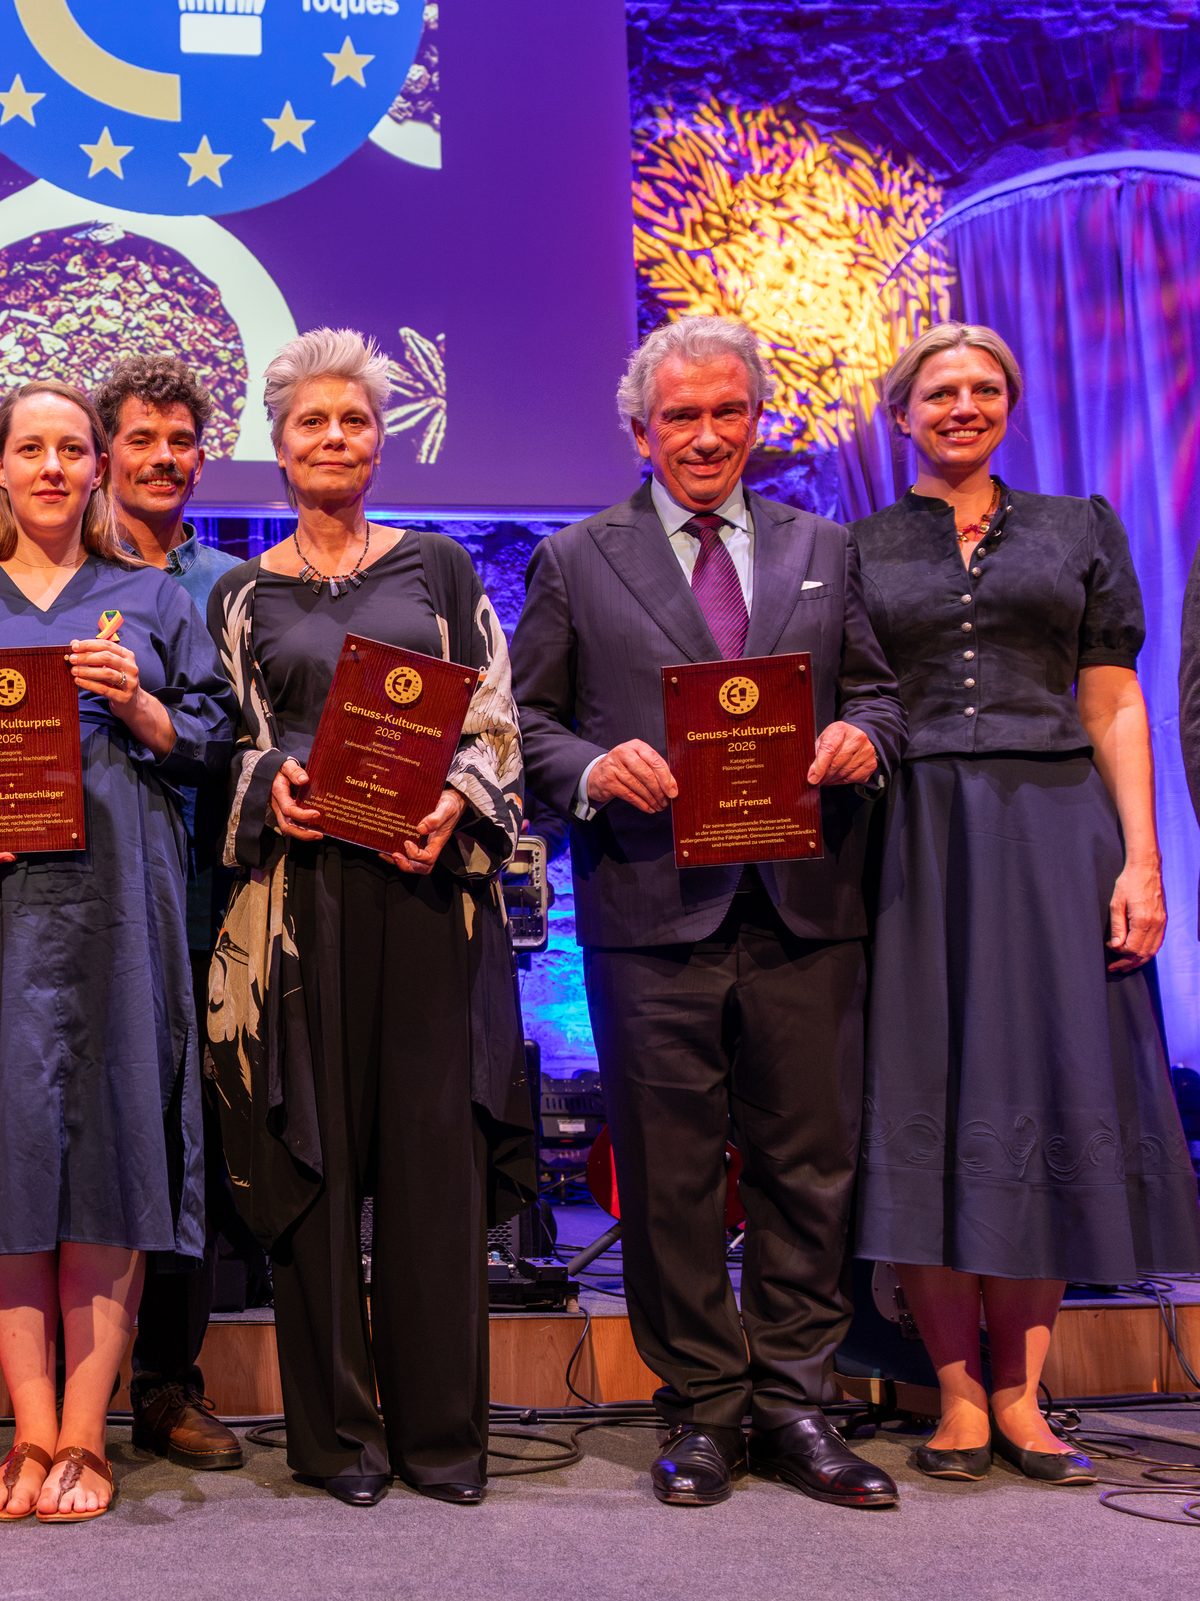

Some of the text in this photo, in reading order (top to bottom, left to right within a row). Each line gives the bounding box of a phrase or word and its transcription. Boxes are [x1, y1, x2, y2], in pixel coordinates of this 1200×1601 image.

[342, 701, 443, 739] Genuss-Kulturpreis
[374, 726, 402, 740] 2026
[687, 722, 796, 743] Genuss-Kulturpreis
[727, 740, 756, 752] 2026
[722, 764, 745, 772] Flüssiger
[345, 776, 399, 797] Sarah Wiener
[0, 789, 64, 801] Lautenschläger
[719, 796, 772, 808] Ralf Frenzel
[24, 812, 51, 820] Verbindung
[374, 814, 393, 822] Kindern
